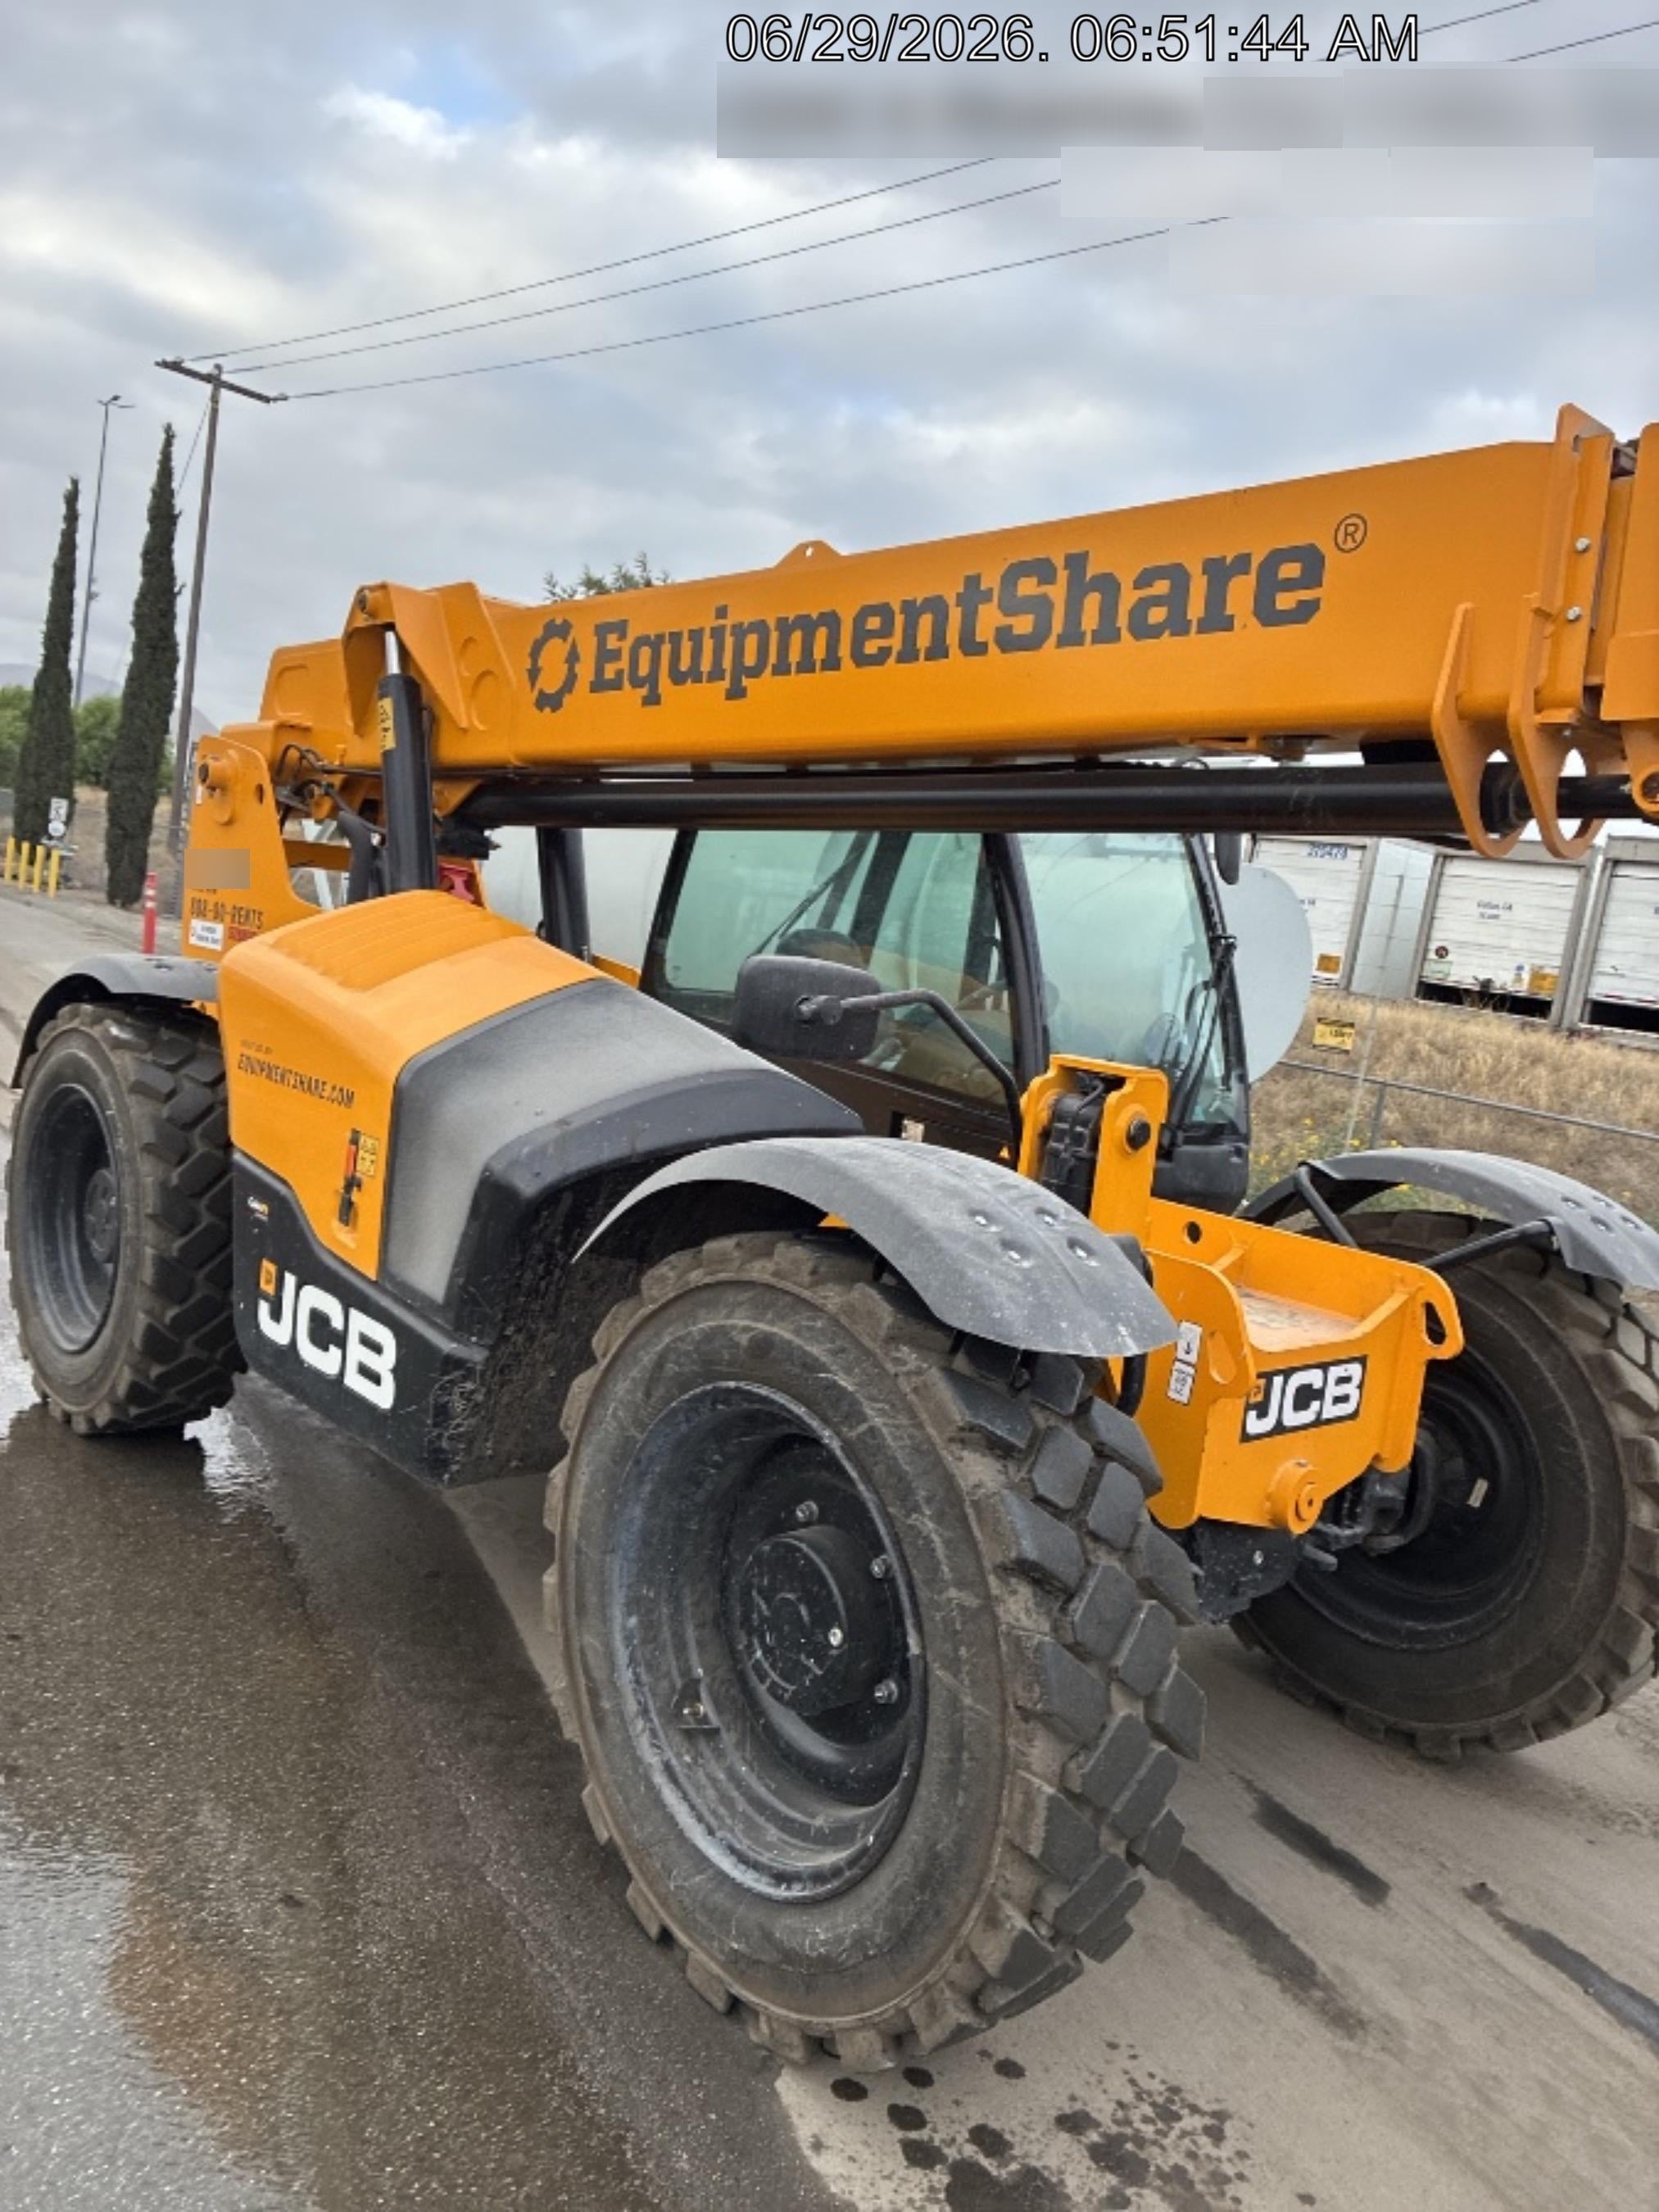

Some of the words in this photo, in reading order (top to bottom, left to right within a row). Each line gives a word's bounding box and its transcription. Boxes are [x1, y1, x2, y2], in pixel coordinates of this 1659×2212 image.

[589, 542, 1326, 707] EquipmentShare
[238, 1053, 355, 1108] EQUIPMENTSHARE.COM
[257, 1270, 397, 1410] JCB
[1245, 1362, 1364, 1436] JCB
